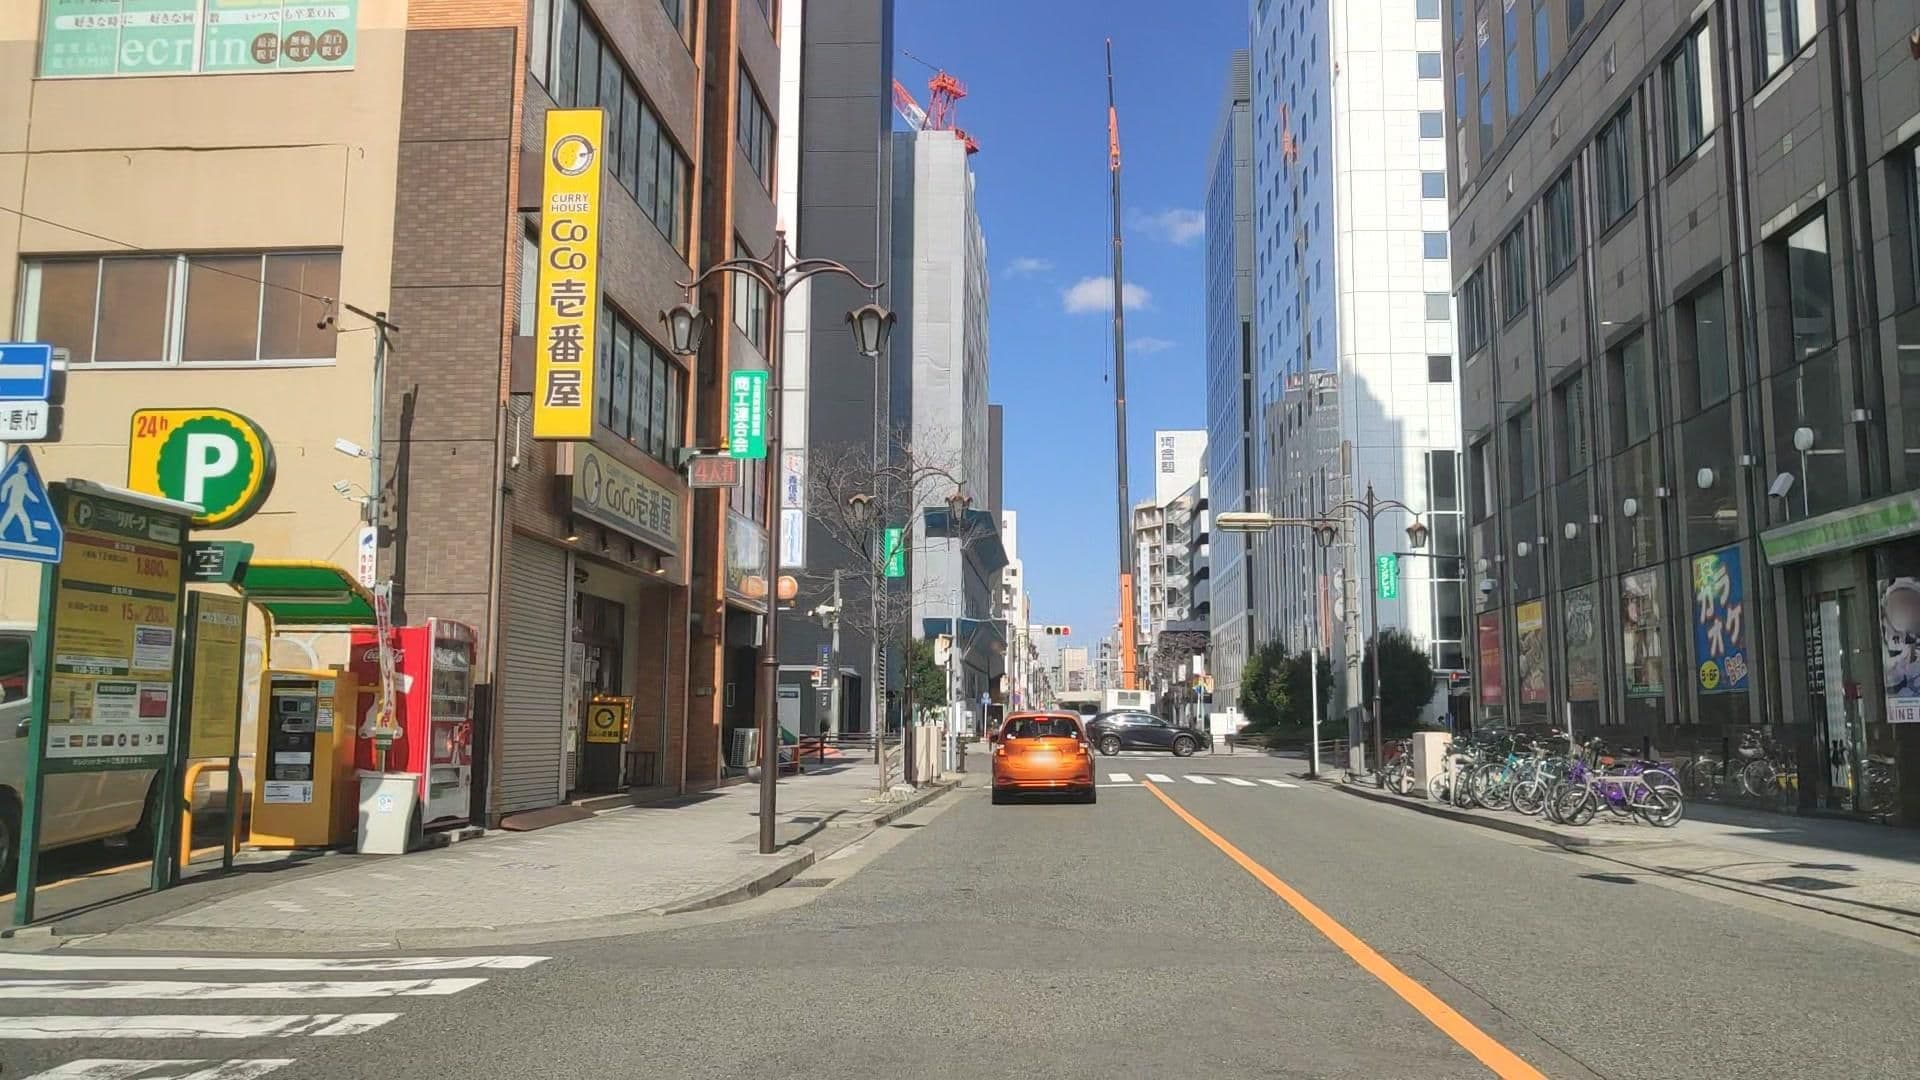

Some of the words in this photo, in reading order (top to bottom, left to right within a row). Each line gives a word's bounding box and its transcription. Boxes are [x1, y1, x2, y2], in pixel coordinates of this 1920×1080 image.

[551, 203, 589, 212] HOUSE
[552, 193, 589, 203] CURRY
[137, 415, 168, 438] 24h
[184, 433, 239, 504] P
[606, 478, 672, 537] CoCo壱番屋
[195, 547, 224, 576] 空
